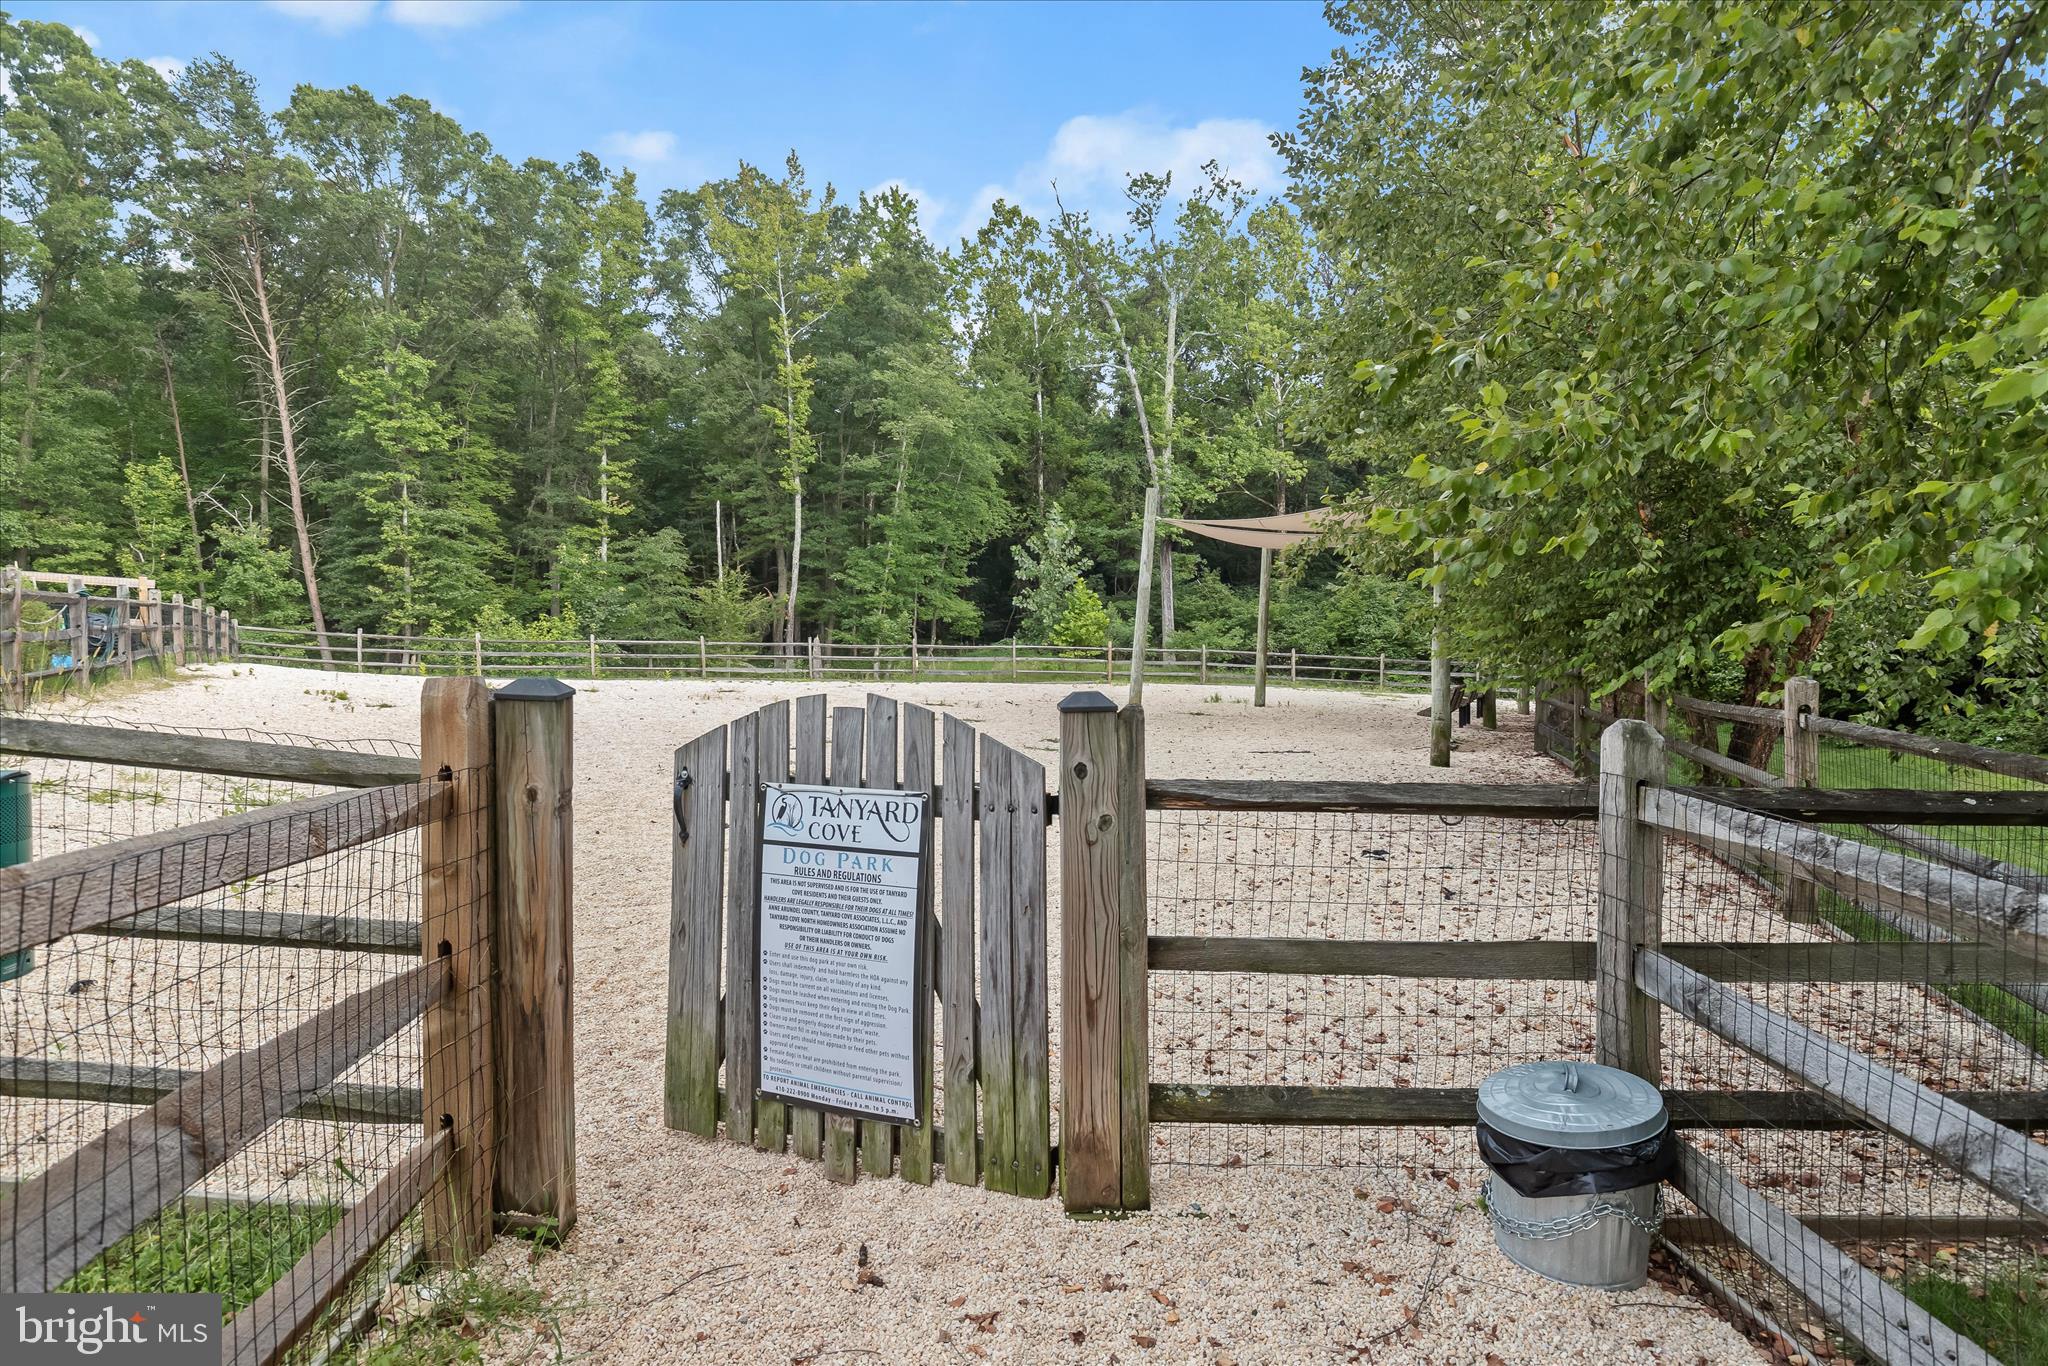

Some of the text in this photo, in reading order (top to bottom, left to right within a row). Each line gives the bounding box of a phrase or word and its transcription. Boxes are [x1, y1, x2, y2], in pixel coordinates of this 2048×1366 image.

[809, 796, 918, 838] TANYARD
[808, 821, 862, 843] COVE
[783, 847, 894, 872] DOG PARK
[794, 866, 882, 883] RULES AND REGULATIONS
[807, 882, 834, 890] SUPERVISED
[886, 890, 907, 898] TANYARD
[781, 906, 801, 914] ARUNDEL
[815, 901, 844, 909] RESPONSIBLE
[779, 924, 814, 933] RESPONSIBILITY
[821, 929, 842, 937] LIABILITY
[853, 933, 874, 941] CONDUCT
[817, 919, 848, 928] HOMEOWNERS
[849, 923, 878, 932] ASSOCIATION
[816, 946, 829, 954] AREA
[770, 1076, 789, 1084] REPORT
[790, 1080, 809, 1088] ANIMAL
[810, 1084, 846, 1095] EMERGENCIES
[850, 1091, 863, 1099] CALL
[864, 1094, 886, 1103] ANIMAL
[887, 1098, 912, 1108] CONTROL
